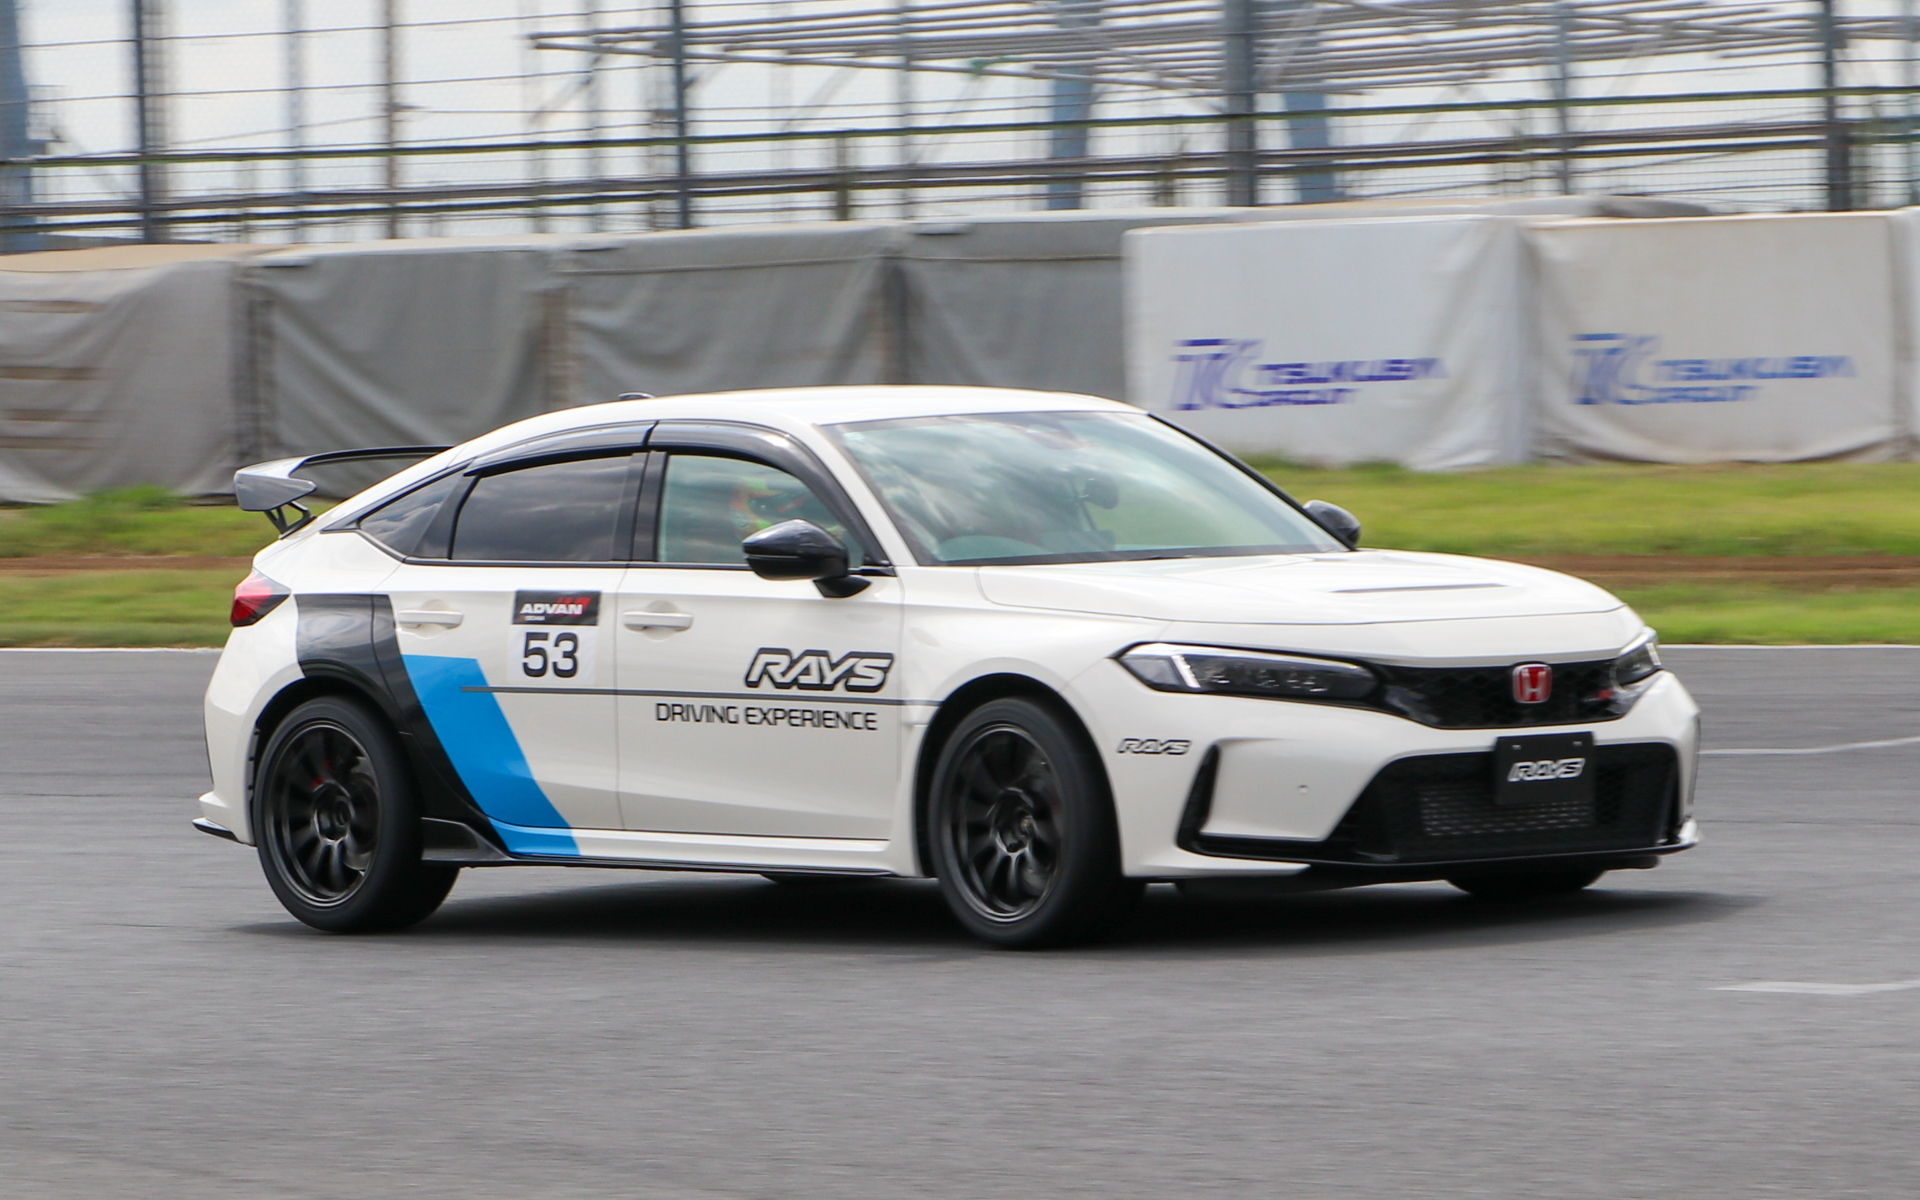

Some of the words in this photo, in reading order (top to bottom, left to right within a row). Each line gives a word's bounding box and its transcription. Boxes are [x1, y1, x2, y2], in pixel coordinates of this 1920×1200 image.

[519, 603, 584, 615] ADVAN
[522, 631, 579, 678] 53
[745, 647, 894, 692] RAYS
[655, 702, 739, 725] DRIVING
[744, 706, 878, 731] EXPERIENCE
[1117, 738, 1191, 755] RAYS
[1507, 758, 1586, 782] RAYS
